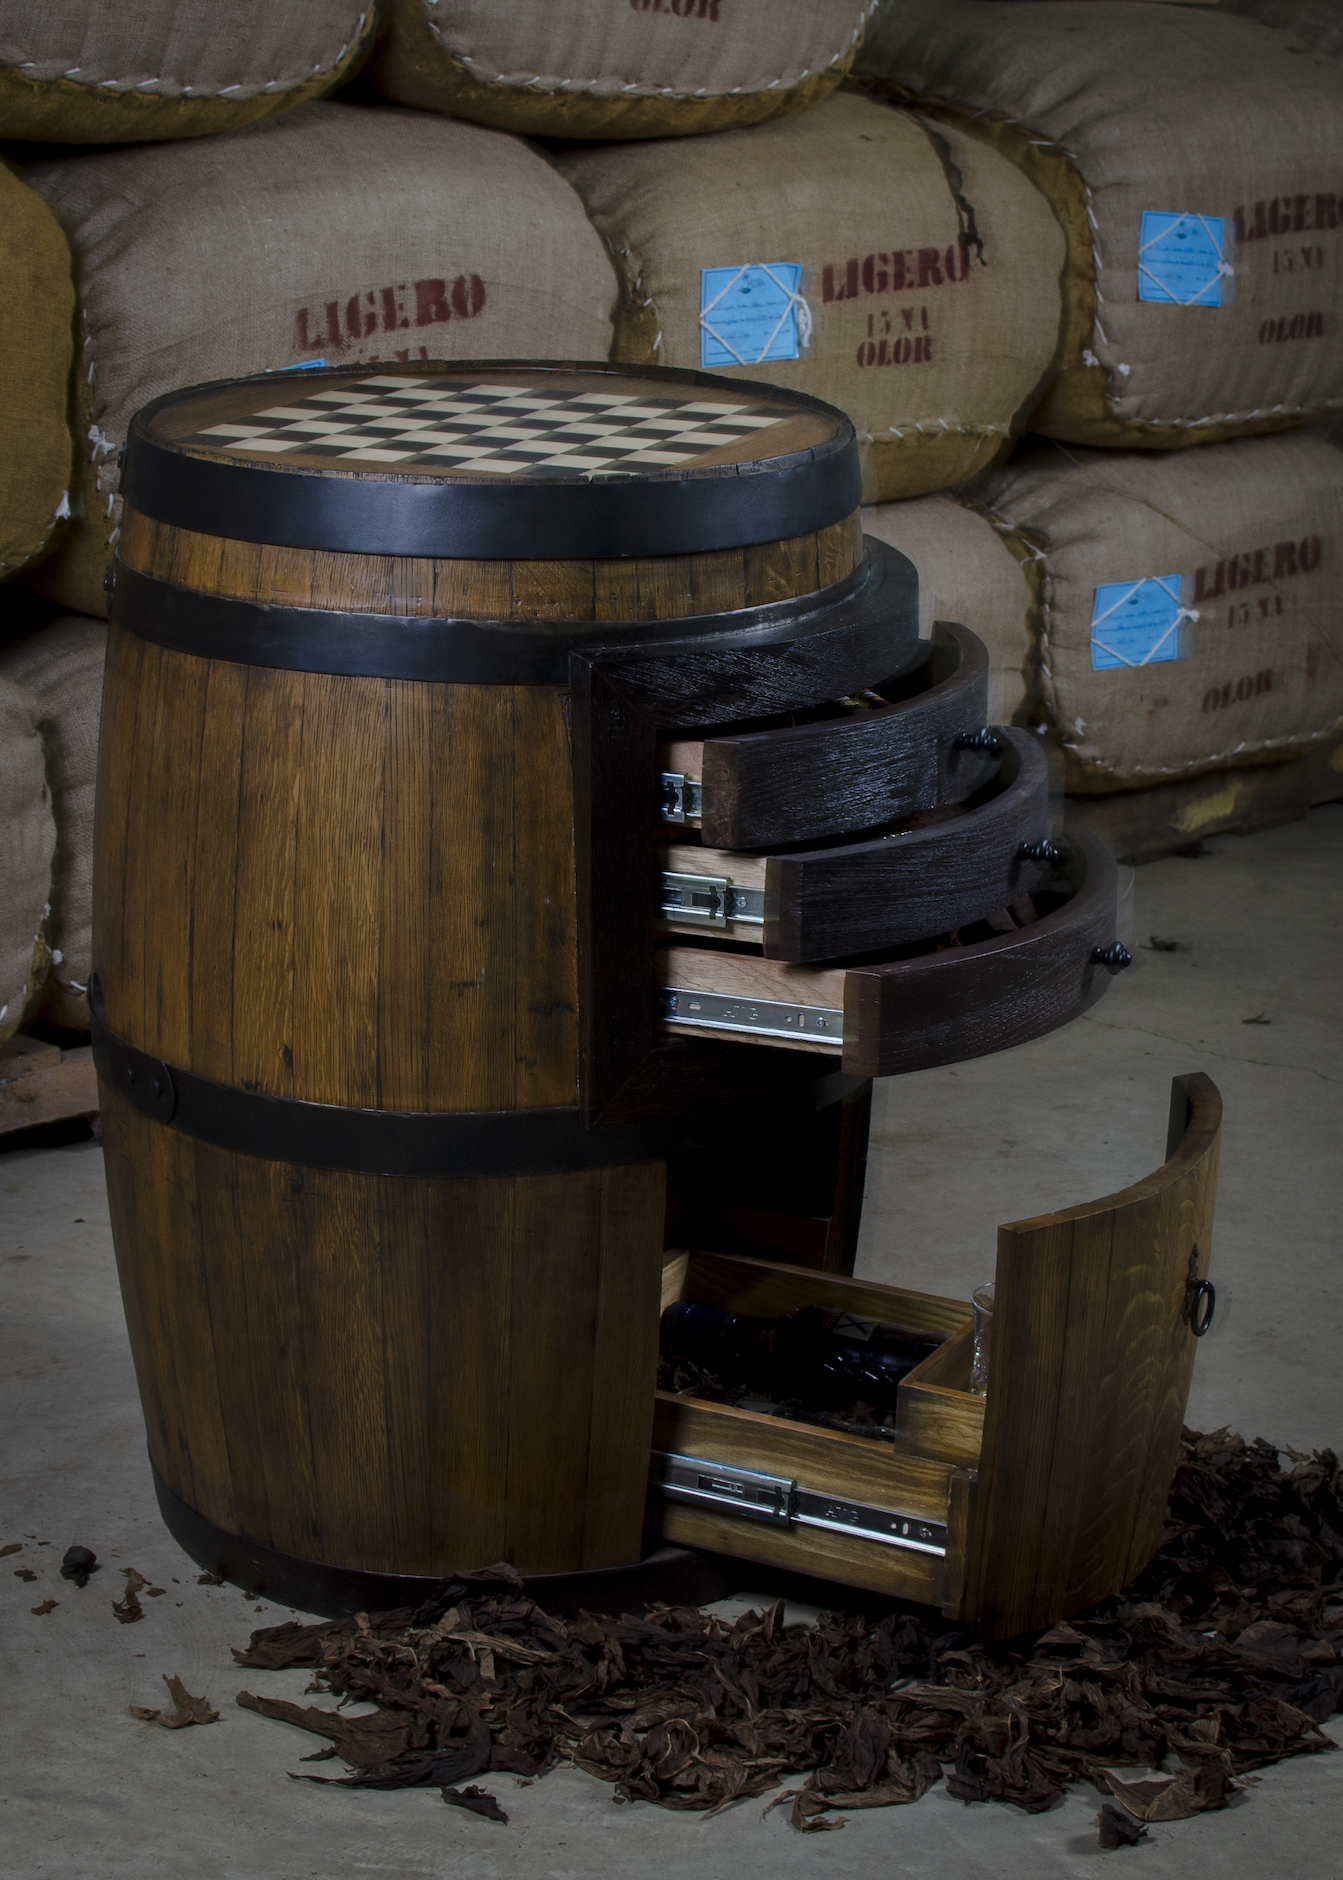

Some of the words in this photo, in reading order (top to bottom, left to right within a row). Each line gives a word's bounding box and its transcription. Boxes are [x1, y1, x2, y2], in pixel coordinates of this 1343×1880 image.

[821, 244, 971, 303] LIGERO
[294, 274, 486, 351] LIGERO
[1258, 311, 1324, 345] OLOR
[856, 335, 933, 368] OLOR
[1193, 534, 1322, 604] LIGERO
[1201, 669, 1273, 713] OLOR
